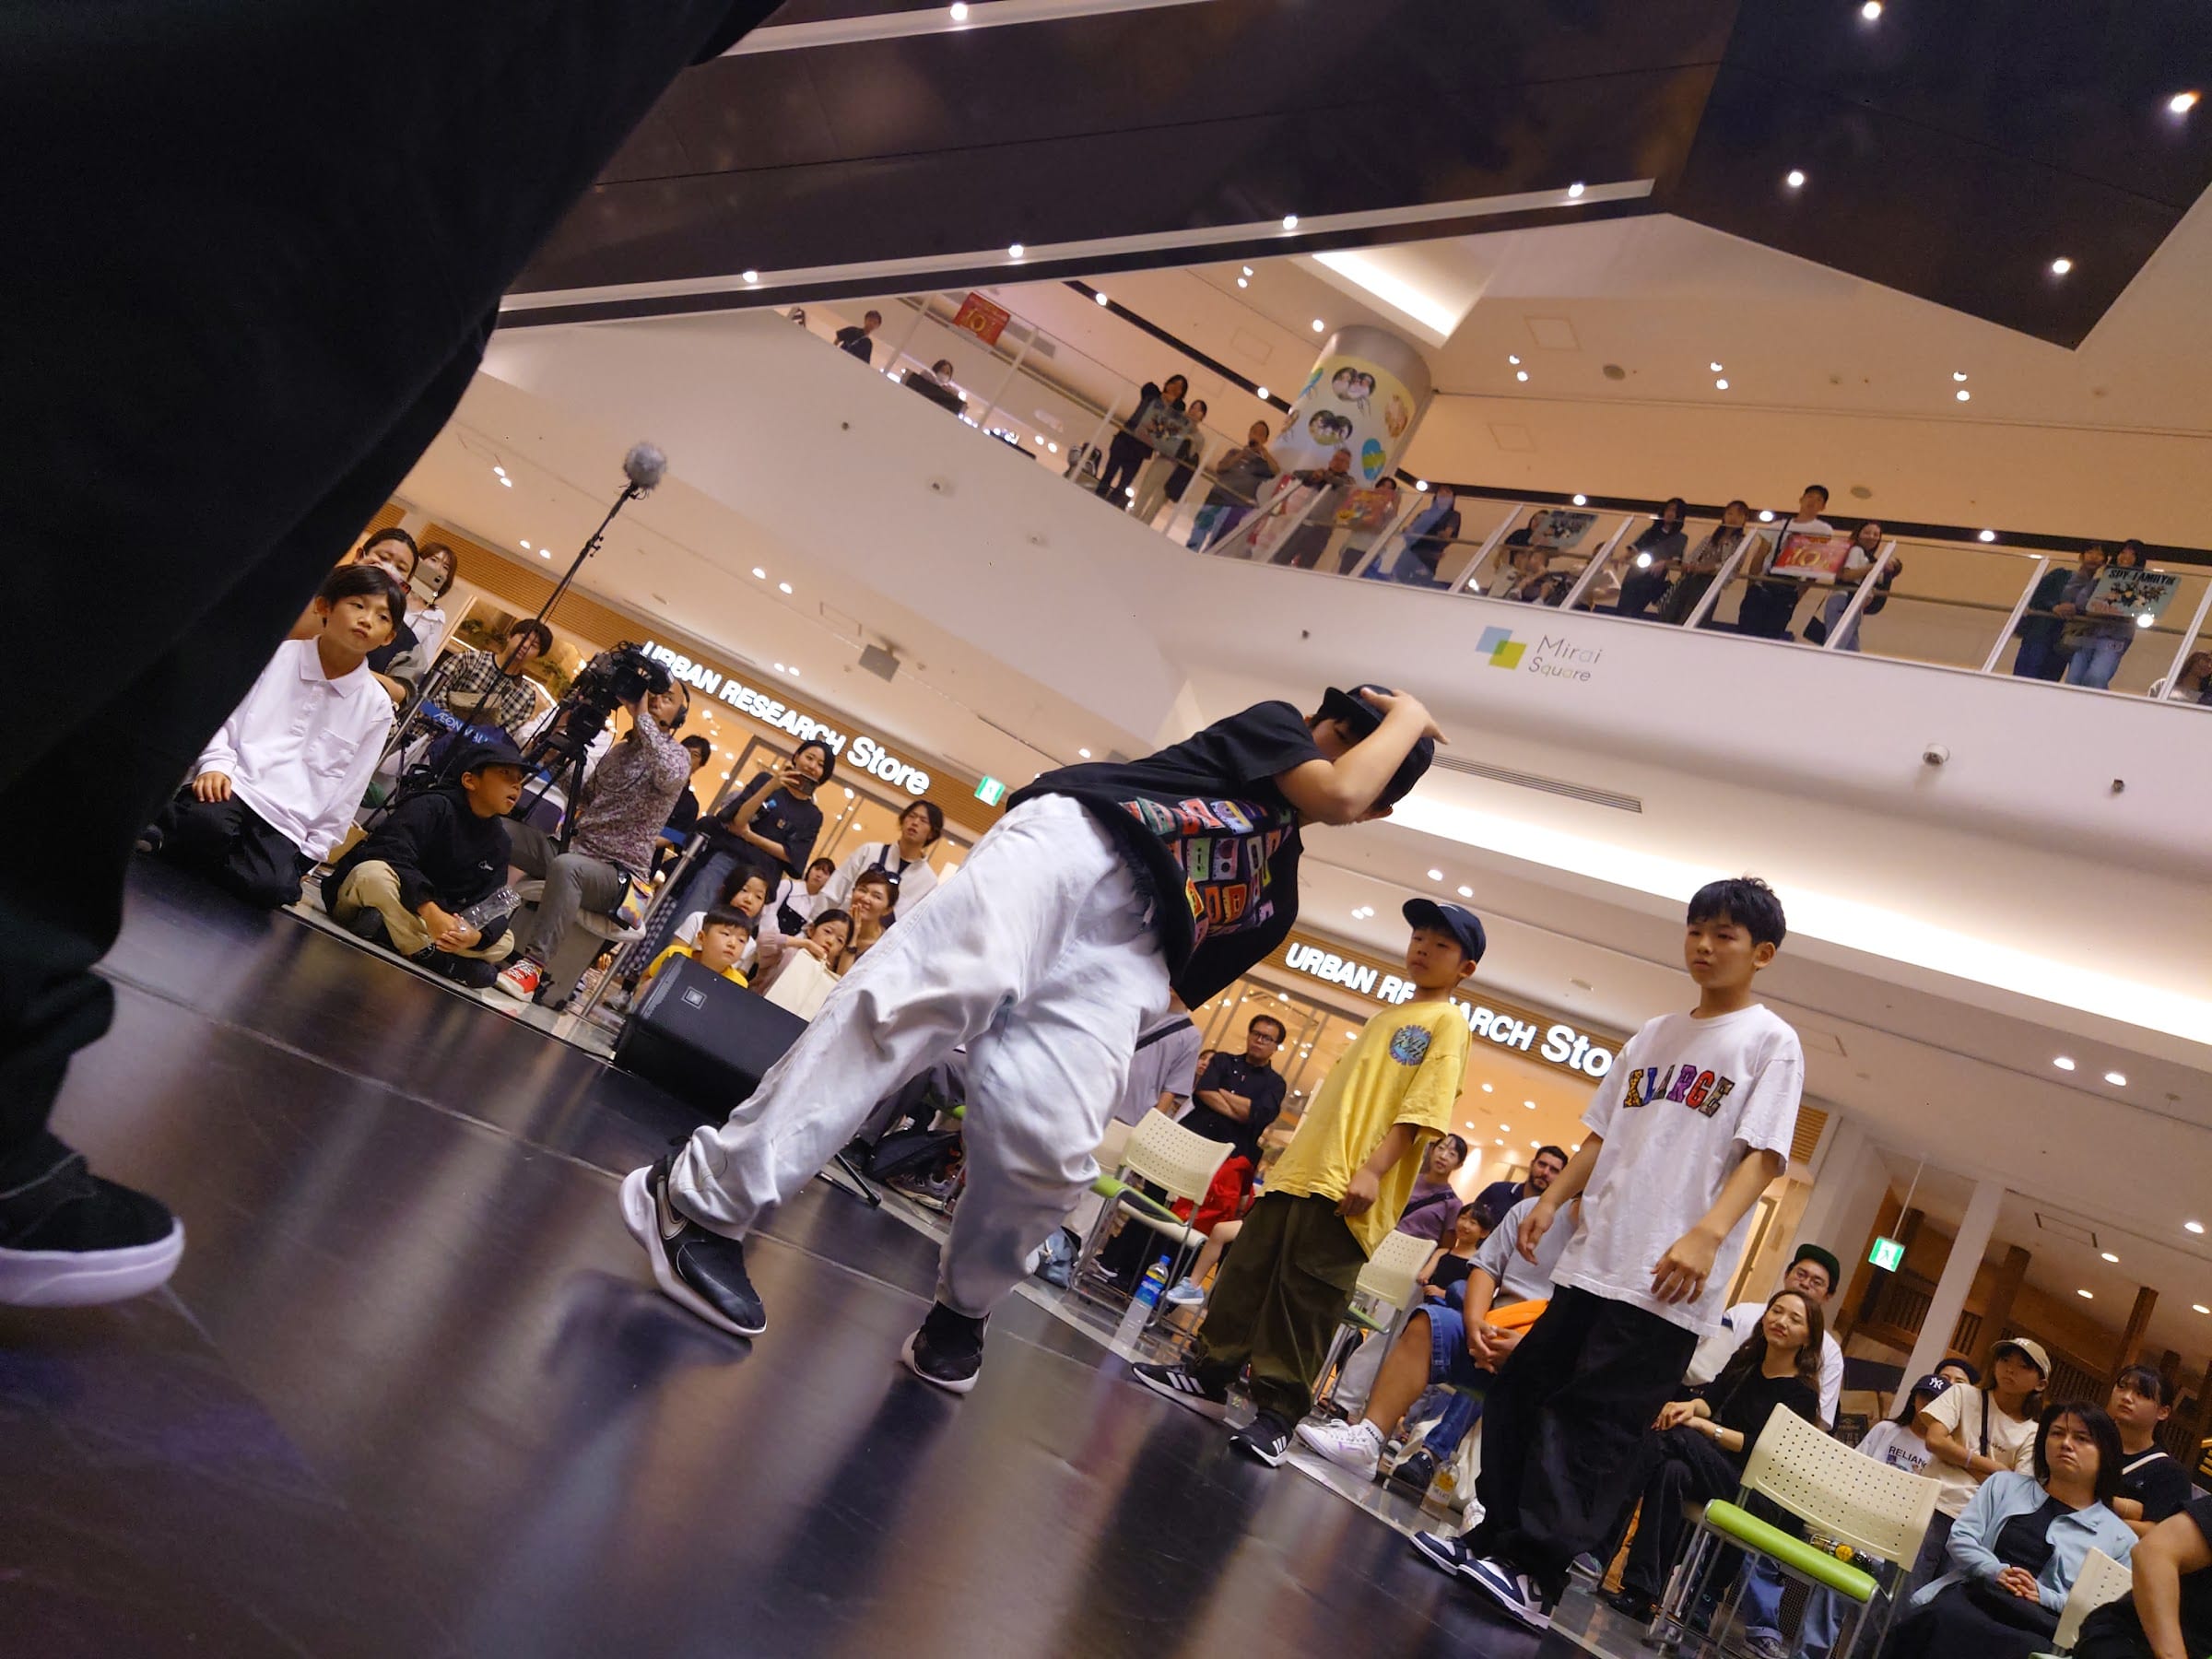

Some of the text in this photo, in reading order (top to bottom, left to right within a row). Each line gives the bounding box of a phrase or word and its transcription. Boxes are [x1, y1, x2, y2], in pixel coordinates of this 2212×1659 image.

[1528, 656, 1591, 682] Square
[1536, 635, 1603, 664] Mirai
[719, 679, 846, 756] RESEARCH
[846, 736, 930, 795] Store
[1285, 942, 1378, 994] URBAN
[1376, 975, 1536, 1051] REARCH
[1540, 1025, 1612, 1077] Sto
